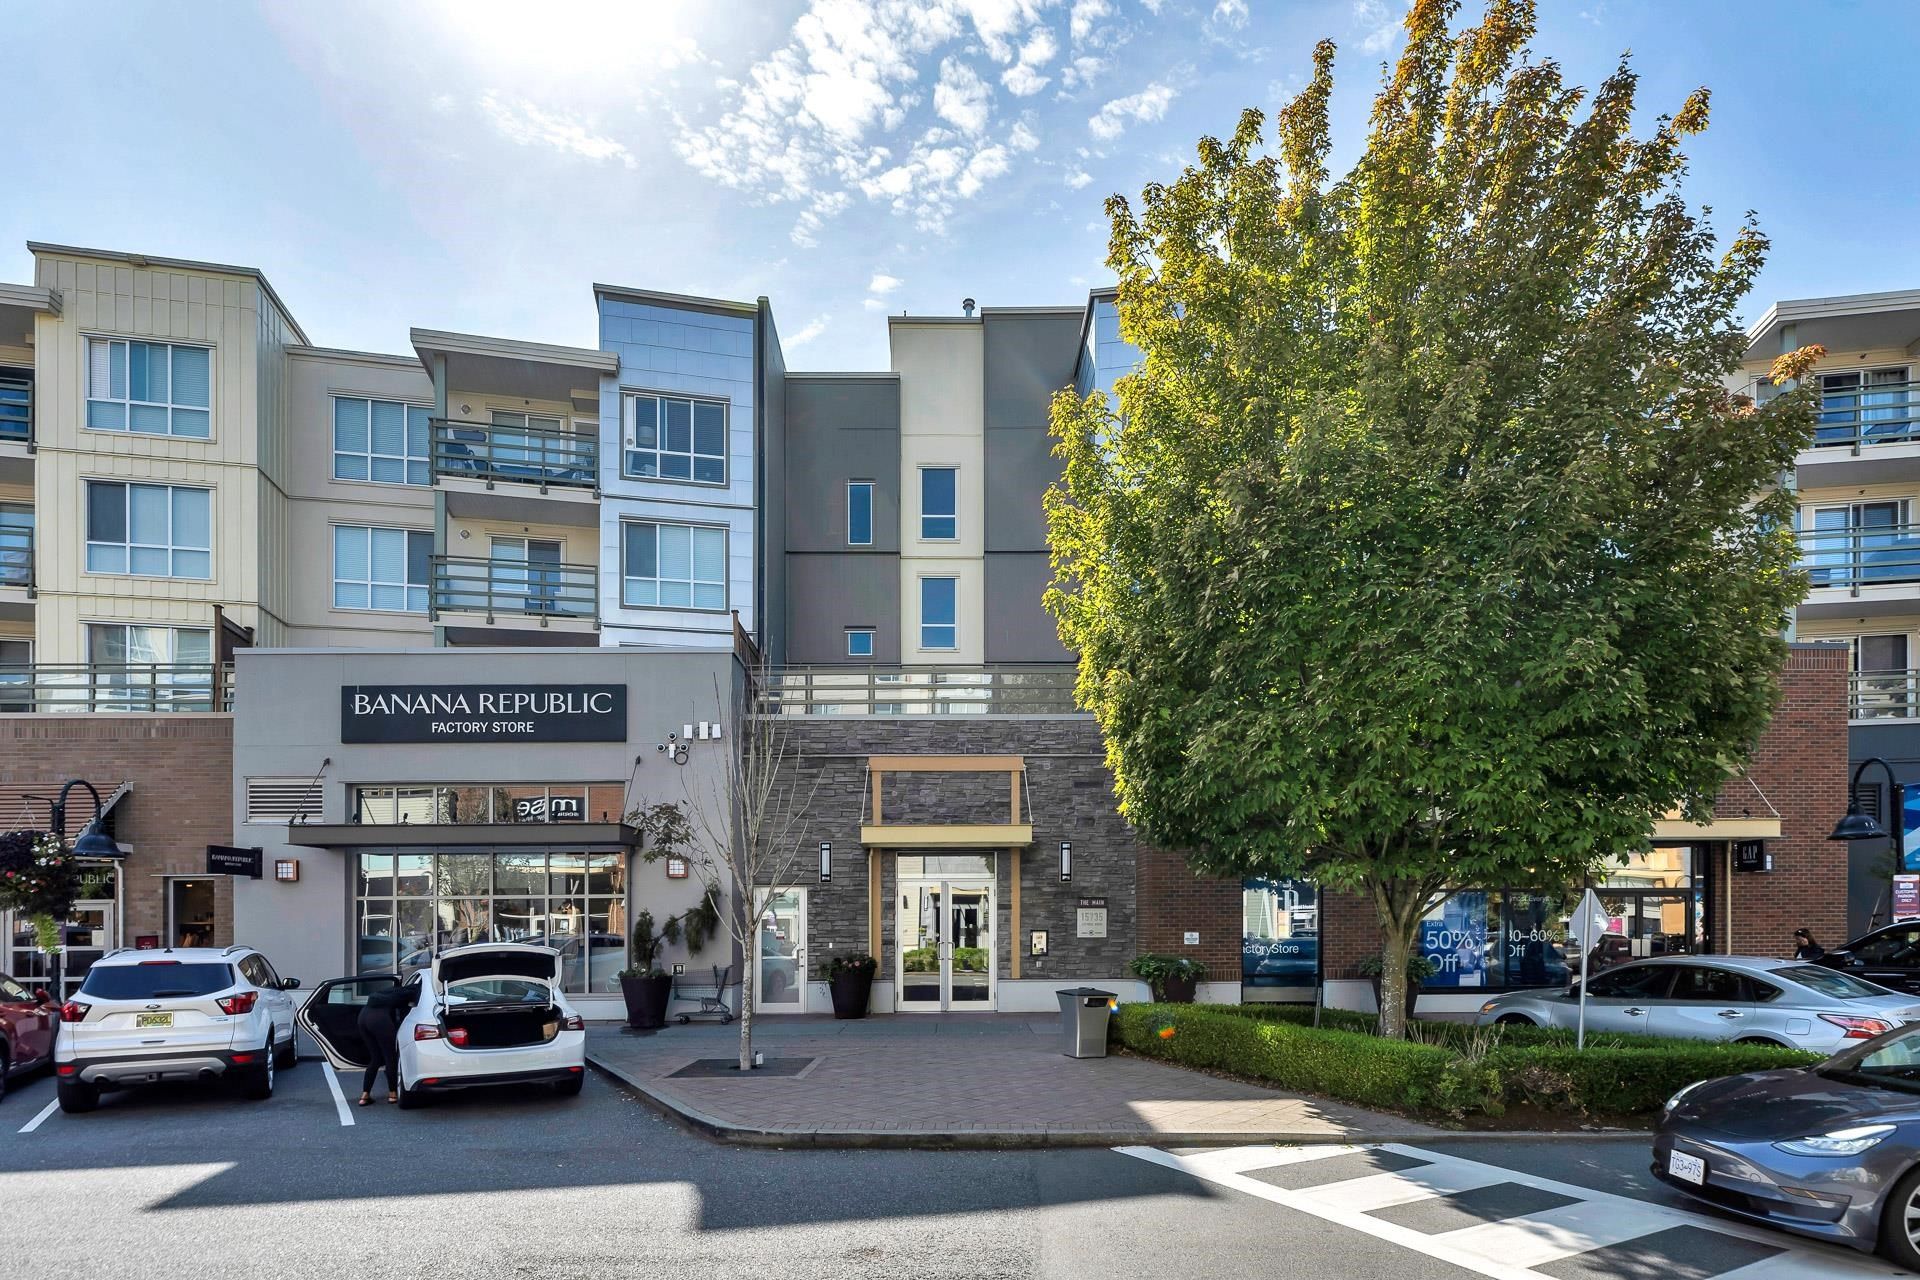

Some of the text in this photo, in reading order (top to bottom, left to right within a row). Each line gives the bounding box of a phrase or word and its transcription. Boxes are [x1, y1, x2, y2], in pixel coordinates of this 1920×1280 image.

[355, 692, 613, 715] BANANA REPUBLIC
[431, 721, 535, 734] FACTORY STORE
[1742, 845, 1757, 860] GAP
[1081, 912, 1103, 921] 15735
[1426, 930, 1475, 950] 50%
[1427, 953, 1459, 972] Off
